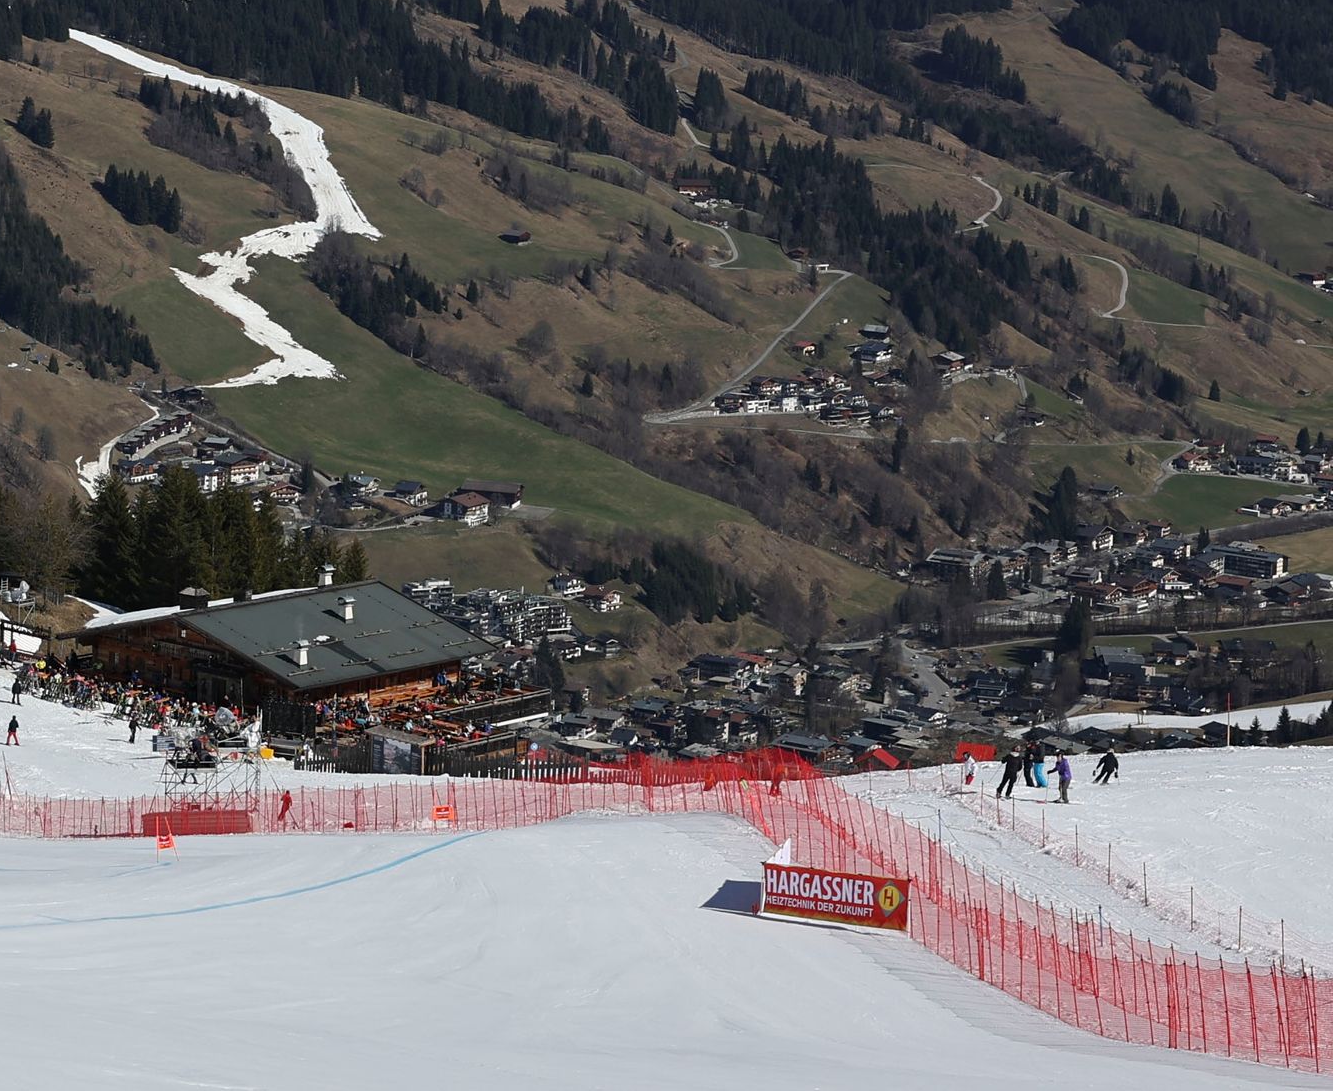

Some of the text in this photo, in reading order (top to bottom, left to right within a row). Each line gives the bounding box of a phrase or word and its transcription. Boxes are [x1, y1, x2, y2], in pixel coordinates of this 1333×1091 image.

[766, 869, 875, 906] HARGASSNER
[766, 895, 874, 917] HEIZTECHNIK DER ZUKUNFT
